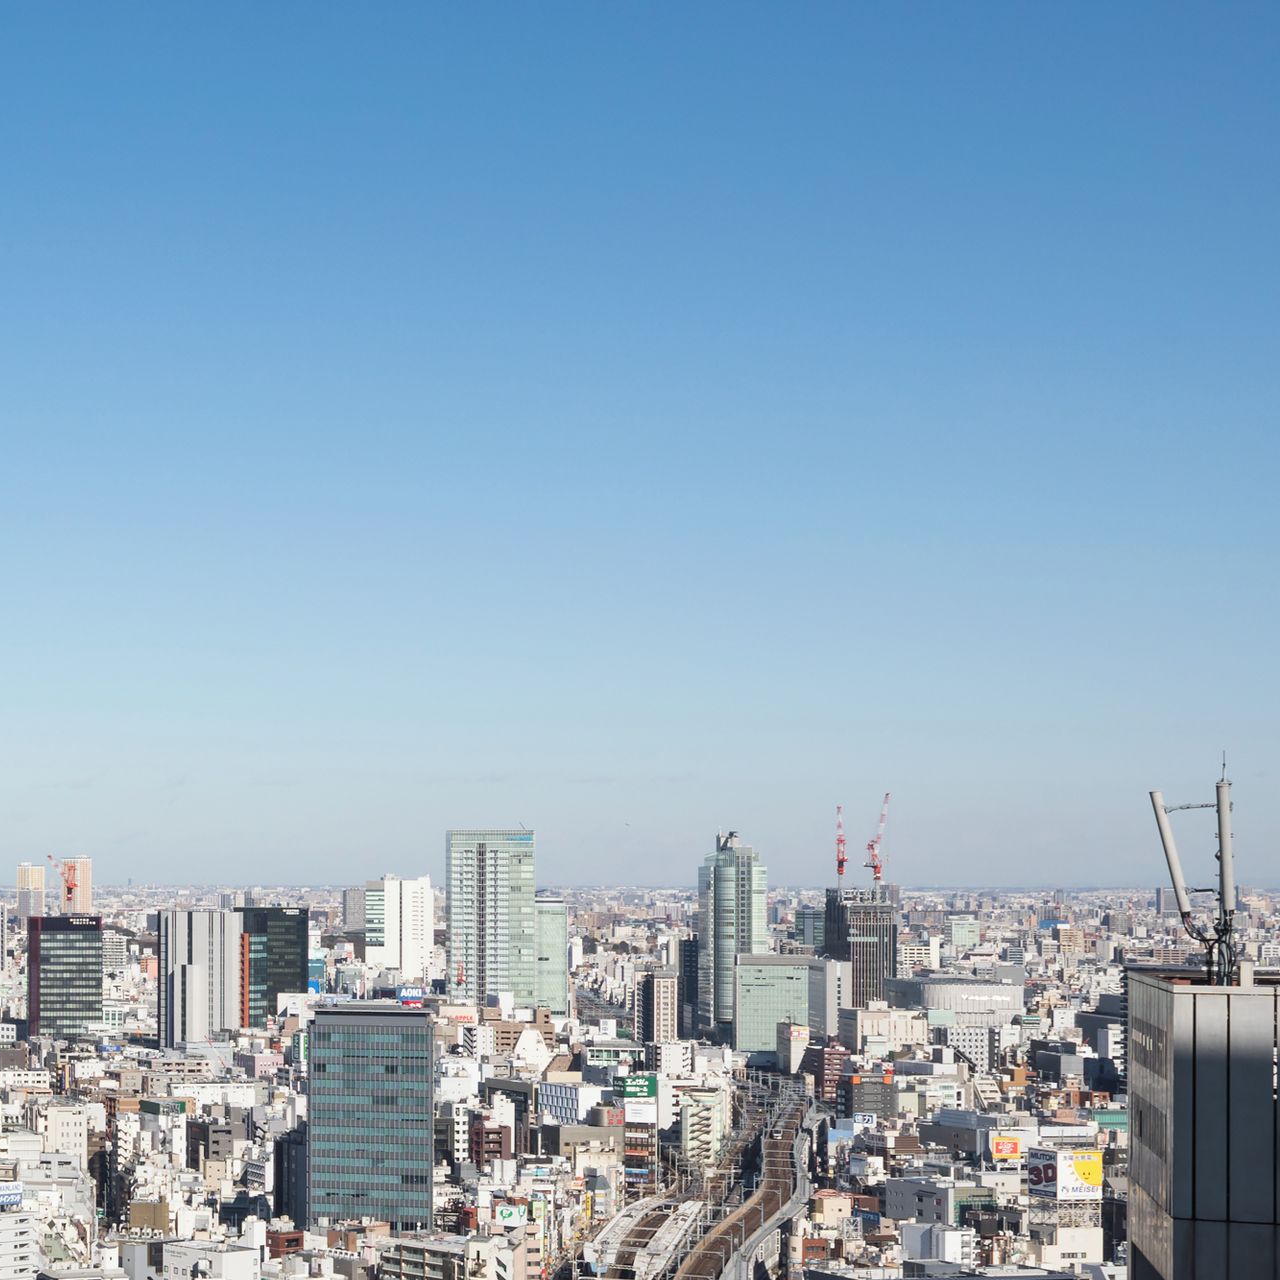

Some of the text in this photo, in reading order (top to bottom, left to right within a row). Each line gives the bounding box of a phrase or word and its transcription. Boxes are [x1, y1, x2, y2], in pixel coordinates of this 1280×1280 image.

[400, 988, 422, 997] AOKI
[1030, 1151, 1056, 1161] MUTOH
[1029, 1162, 1056, 1186] 3D
[1072, 1185, 1099, 1193] MEISEI
